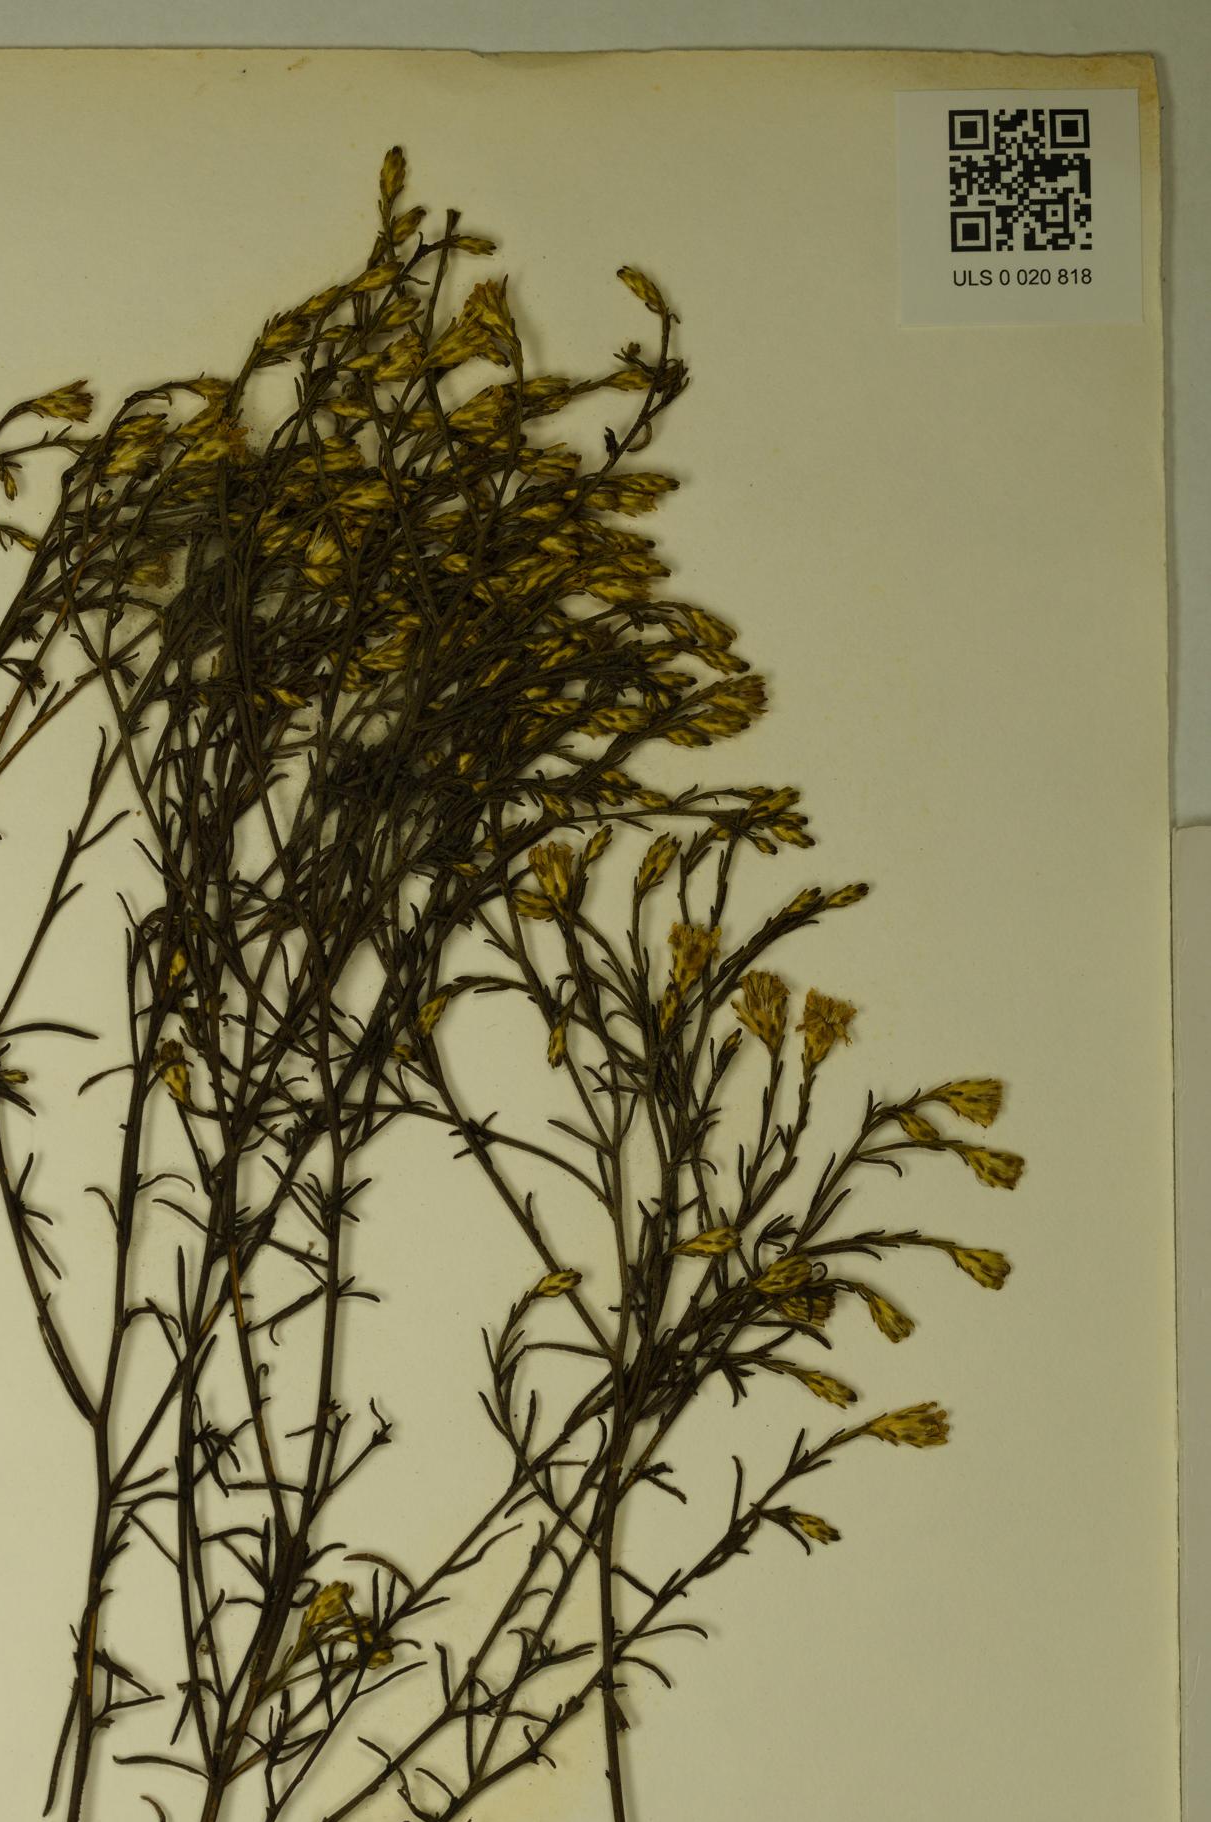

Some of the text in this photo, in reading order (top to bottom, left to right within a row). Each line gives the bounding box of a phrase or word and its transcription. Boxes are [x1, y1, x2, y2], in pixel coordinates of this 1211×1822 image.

[953, 268, 1092, 287] ULS 0 020 818
